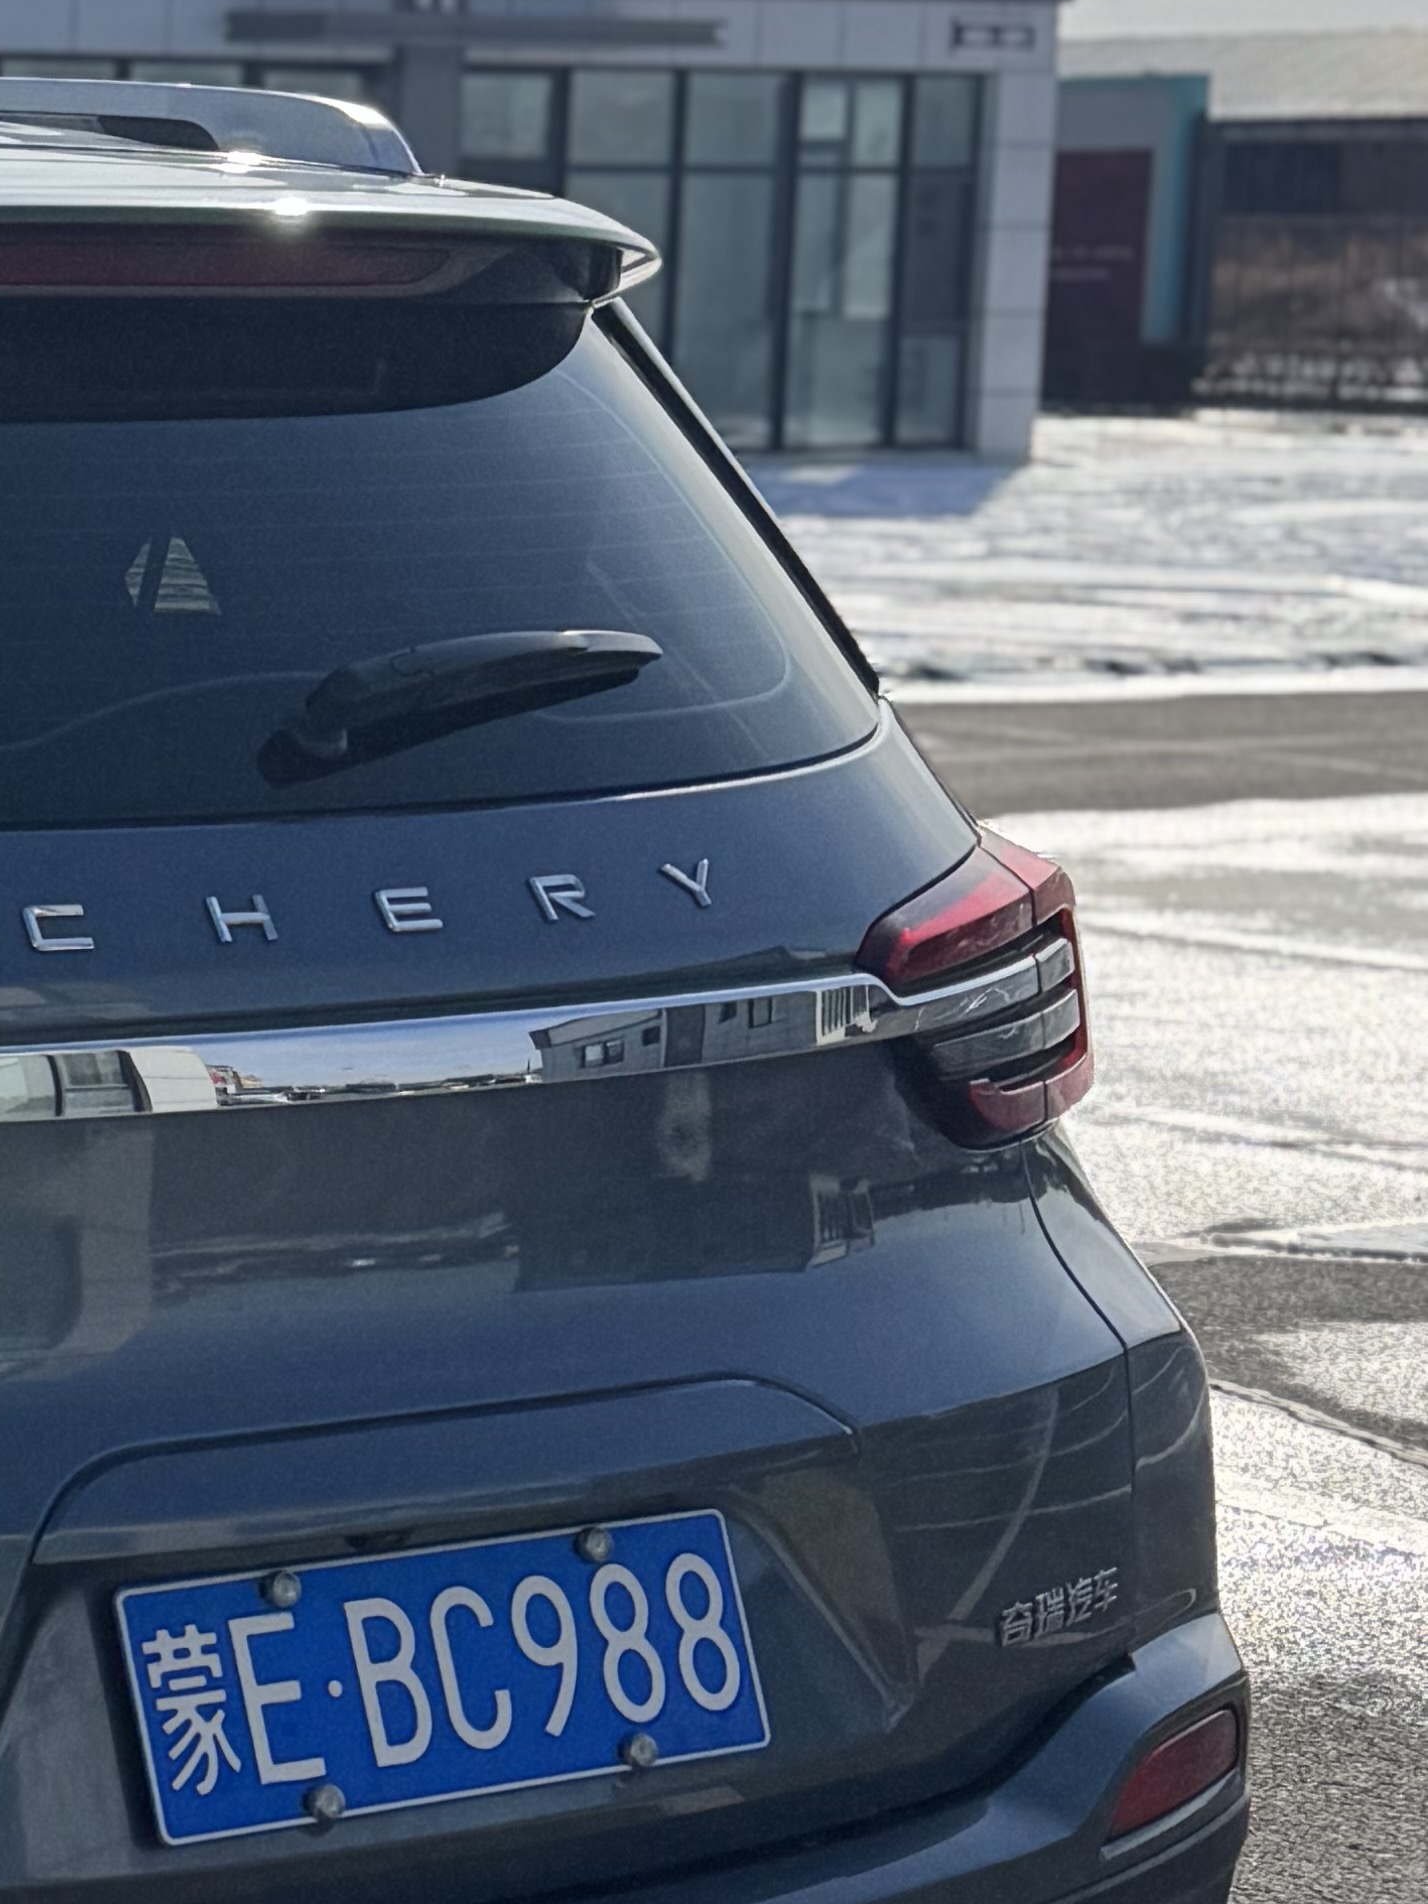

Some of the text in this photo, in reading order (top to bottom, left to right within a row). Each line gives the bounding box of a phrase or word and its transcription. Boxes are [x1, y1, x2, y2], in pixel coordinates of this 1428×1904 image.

[23, 858, 712, 952] CHERY
[1001, 1566, 1119, 1648] 奇瑞汽车
